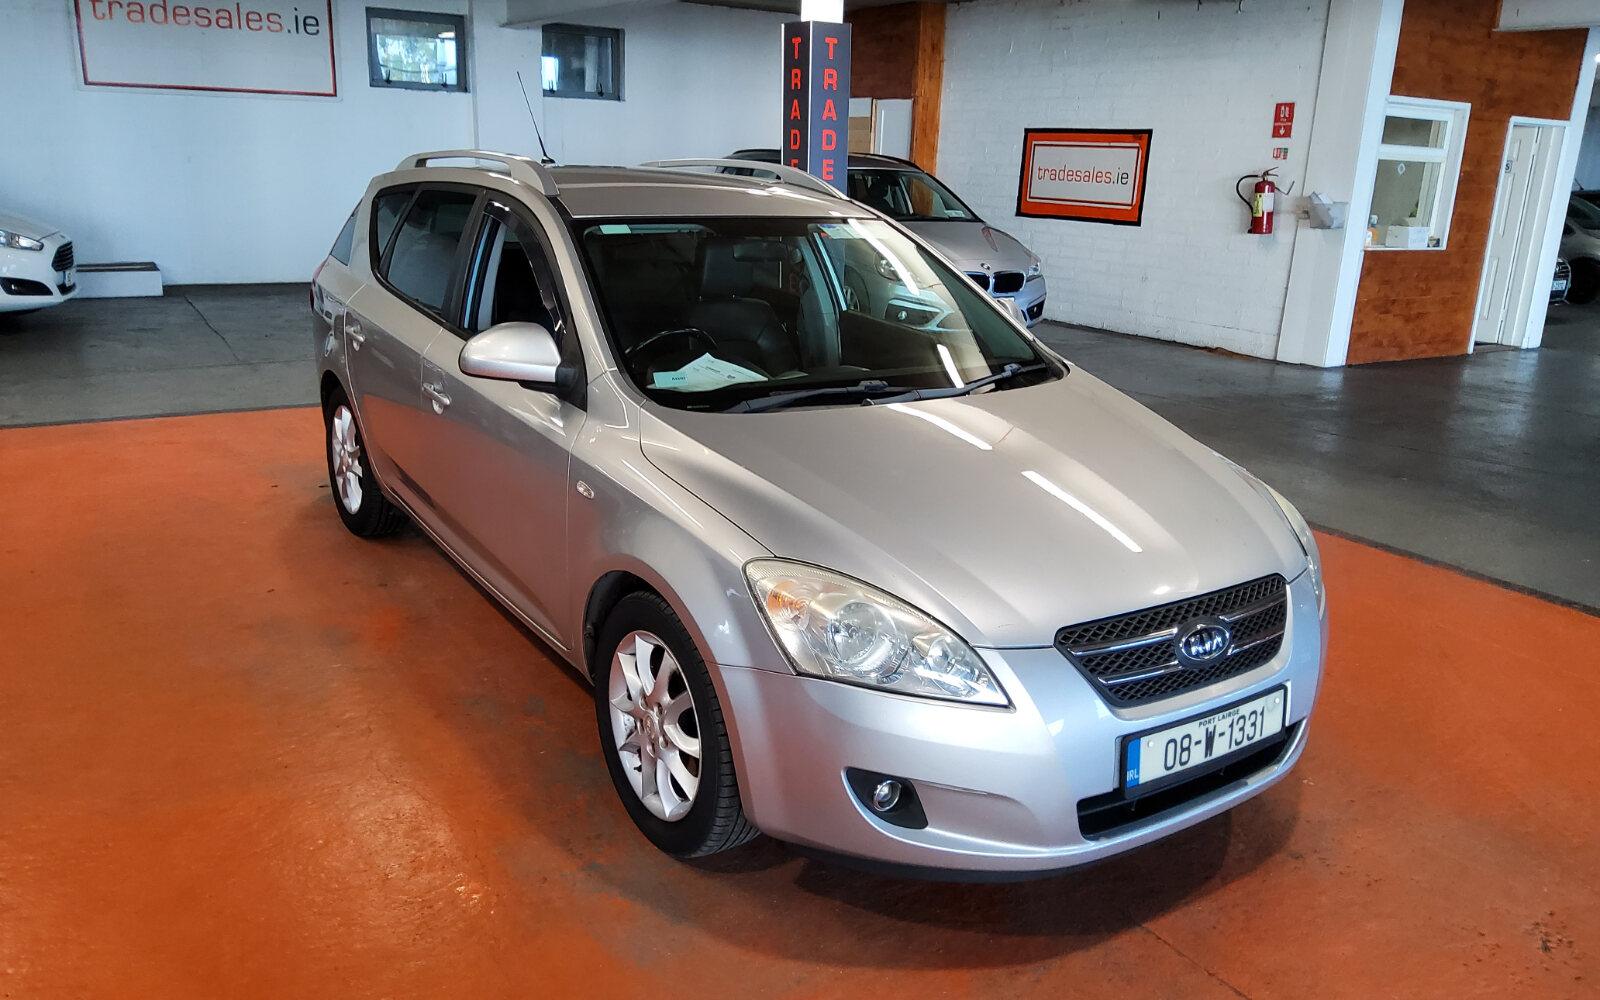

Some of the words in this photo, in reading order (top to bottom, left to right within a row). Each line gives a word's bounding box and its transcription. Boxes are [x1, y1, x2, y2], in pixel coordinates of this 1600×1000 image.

[90, 0, 320, 36] tradesales.ie
[822, 36, 838, 181] TRADE
[1037, 163, 1129, 185] tradesales.ie
[1189, 631, 1223, 655] KIA
[1198, 717, 1216, 728] PORT
[1217, 709, 1240, 721] LAIRGE
[1163, 706, 1265, 771] 08-W-1331
[1126, 768, 1139, 782] IRL
